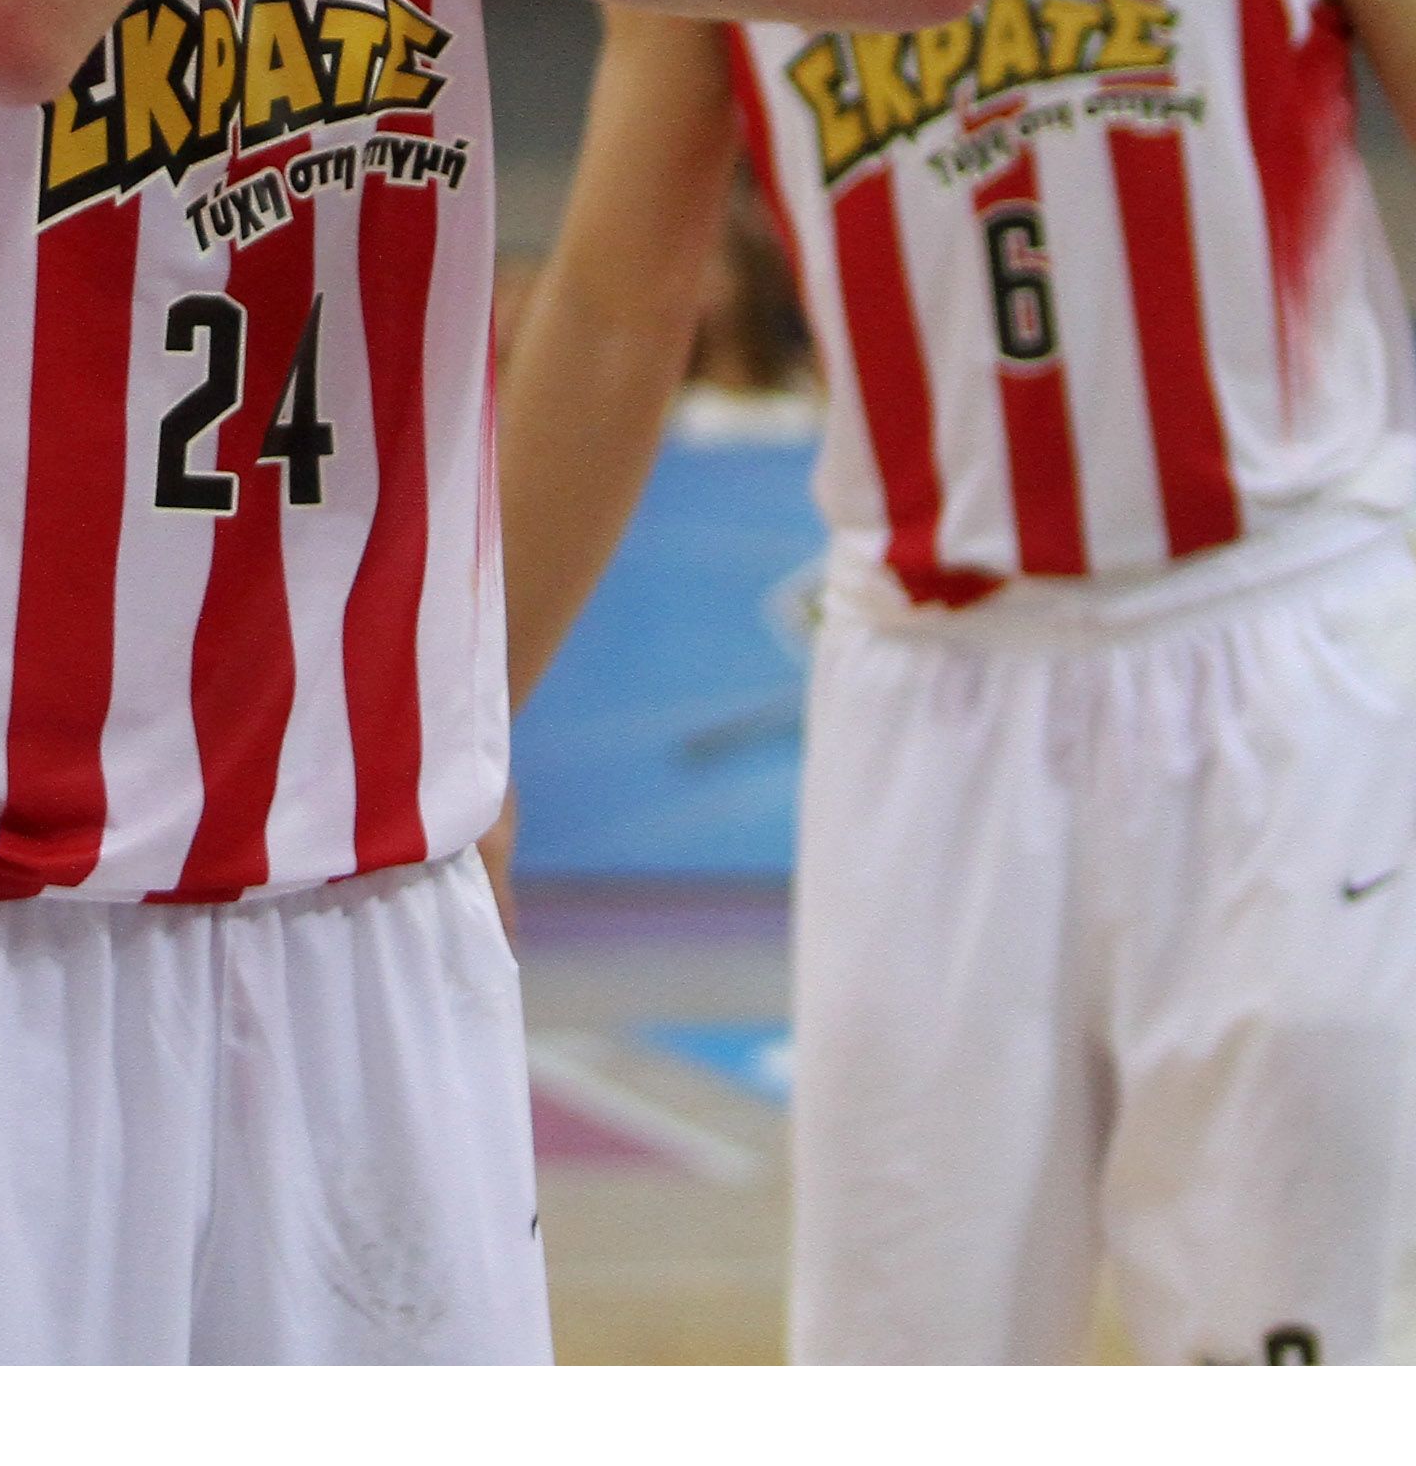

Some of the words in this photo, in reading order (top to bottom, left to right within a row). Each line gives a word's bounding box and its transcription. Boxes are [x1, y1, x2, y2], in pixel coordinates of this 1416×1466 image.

[186, 172, 288, 252] Τύχη
[289, 145, 356, 190] στη
[986, 209, 1056, 362] 6
[153, 292, 335, 511] 24
